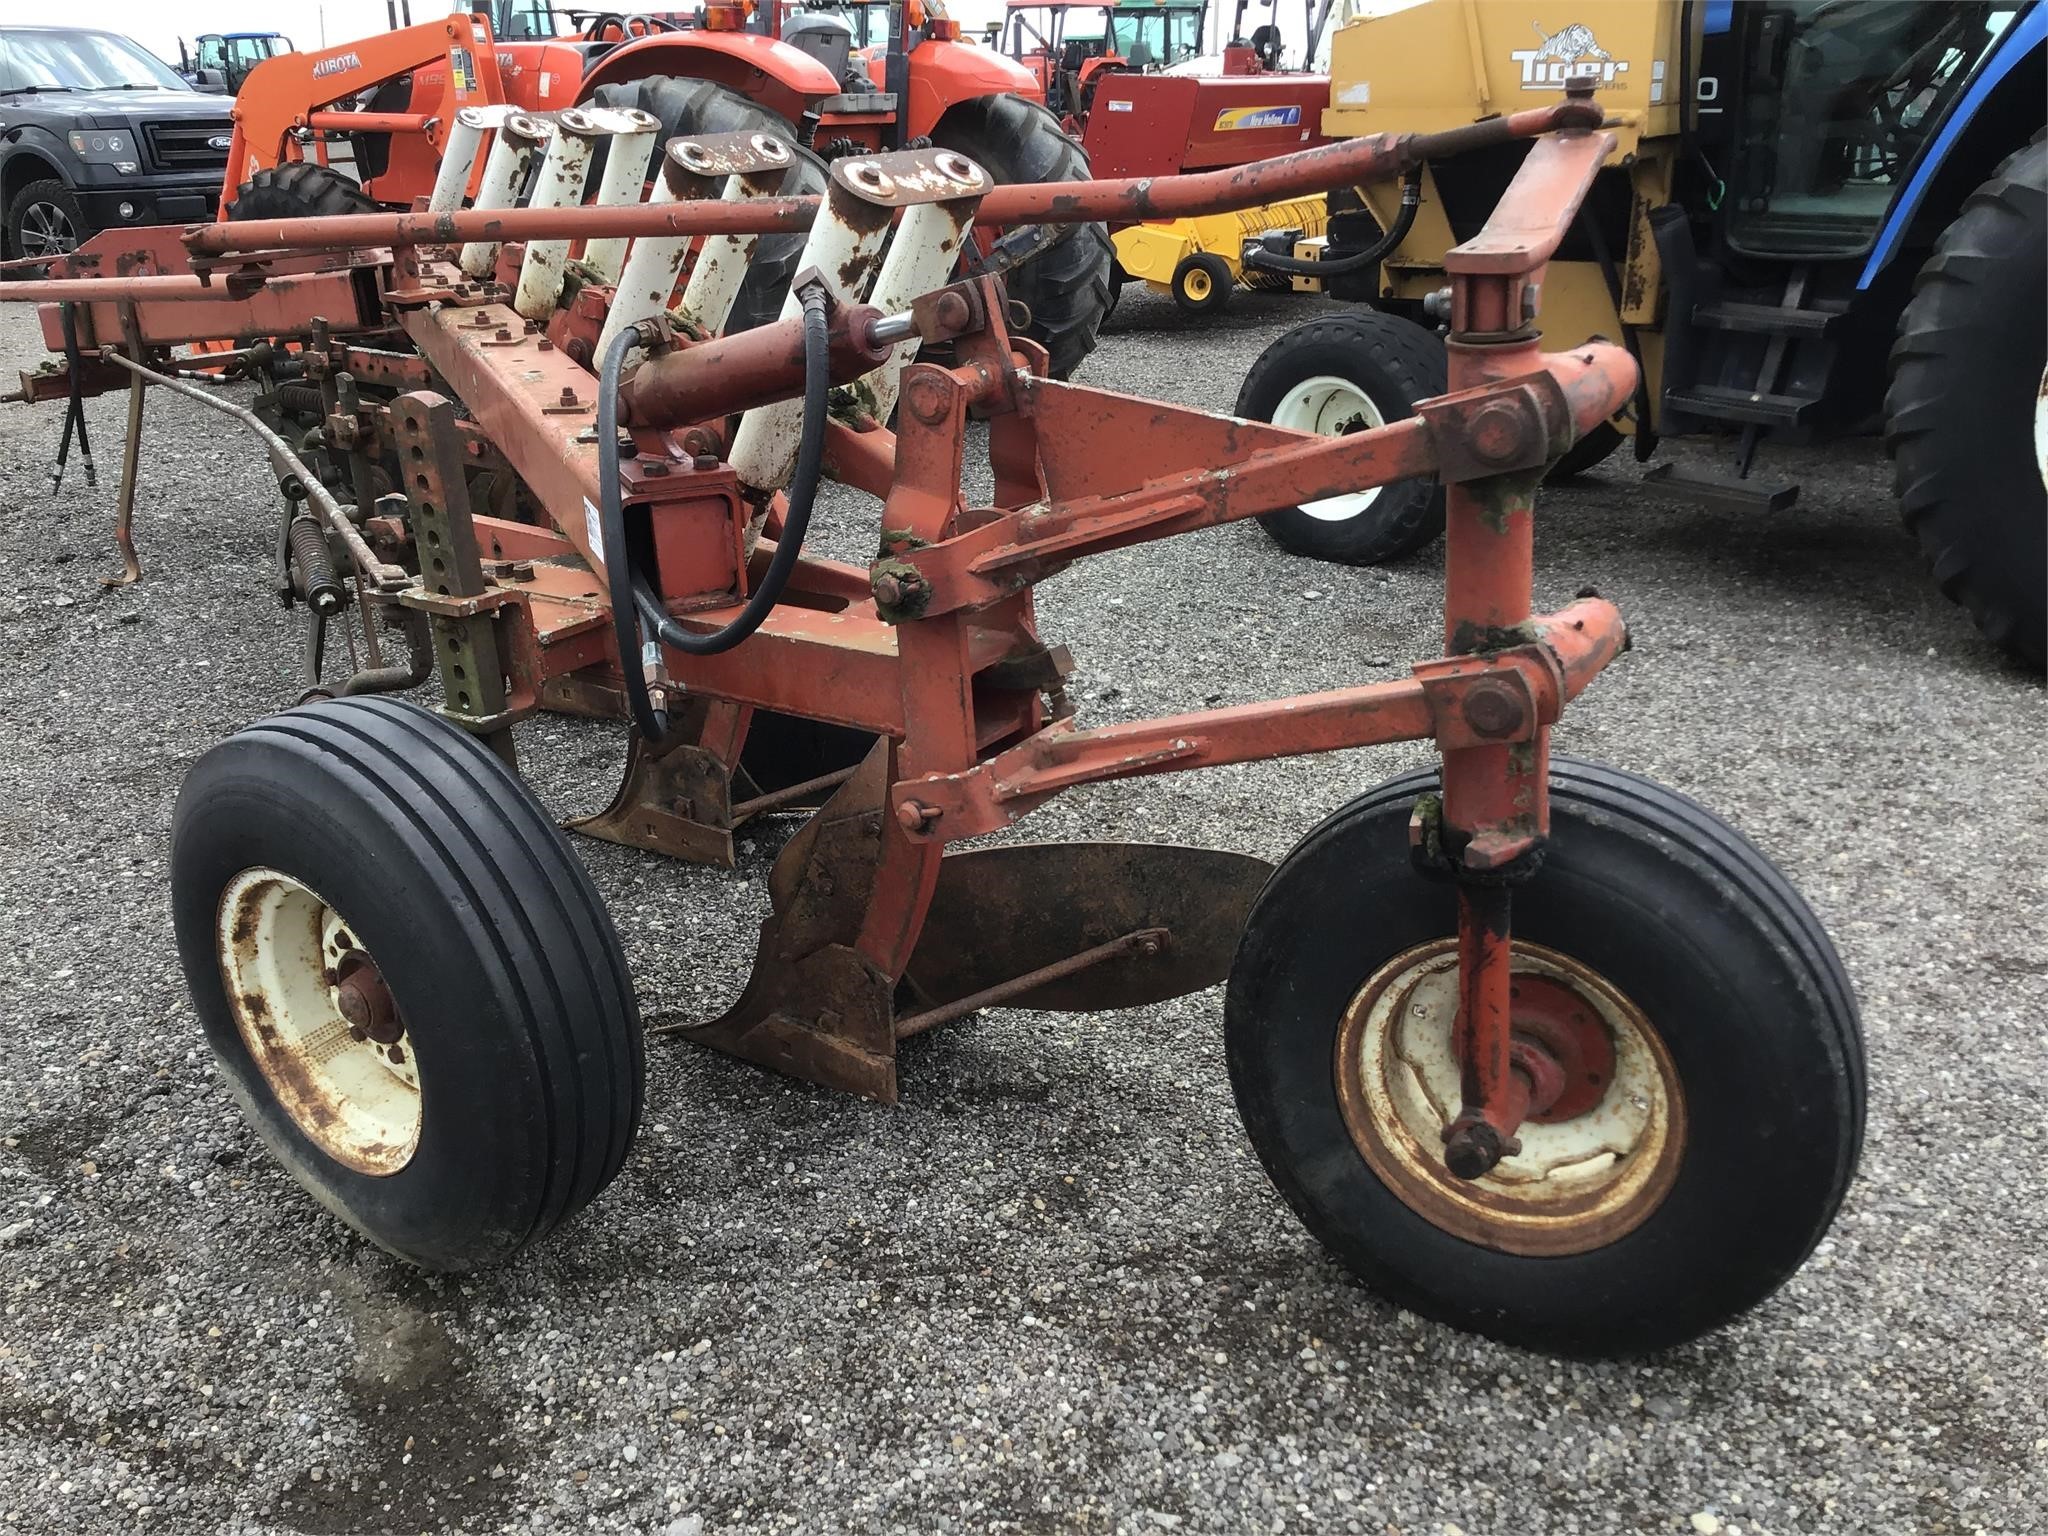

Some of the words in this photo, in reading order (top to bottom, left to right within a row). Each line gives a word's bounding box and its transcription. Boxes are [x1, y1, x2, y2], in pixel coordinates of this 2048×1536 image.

[313, 52, 362, 80] KUBOTA
[1510, 50, 1629, 90] Tiger
[1249, 113, 1263, 127] New
[1262, 112, 1285, 126] Holland
